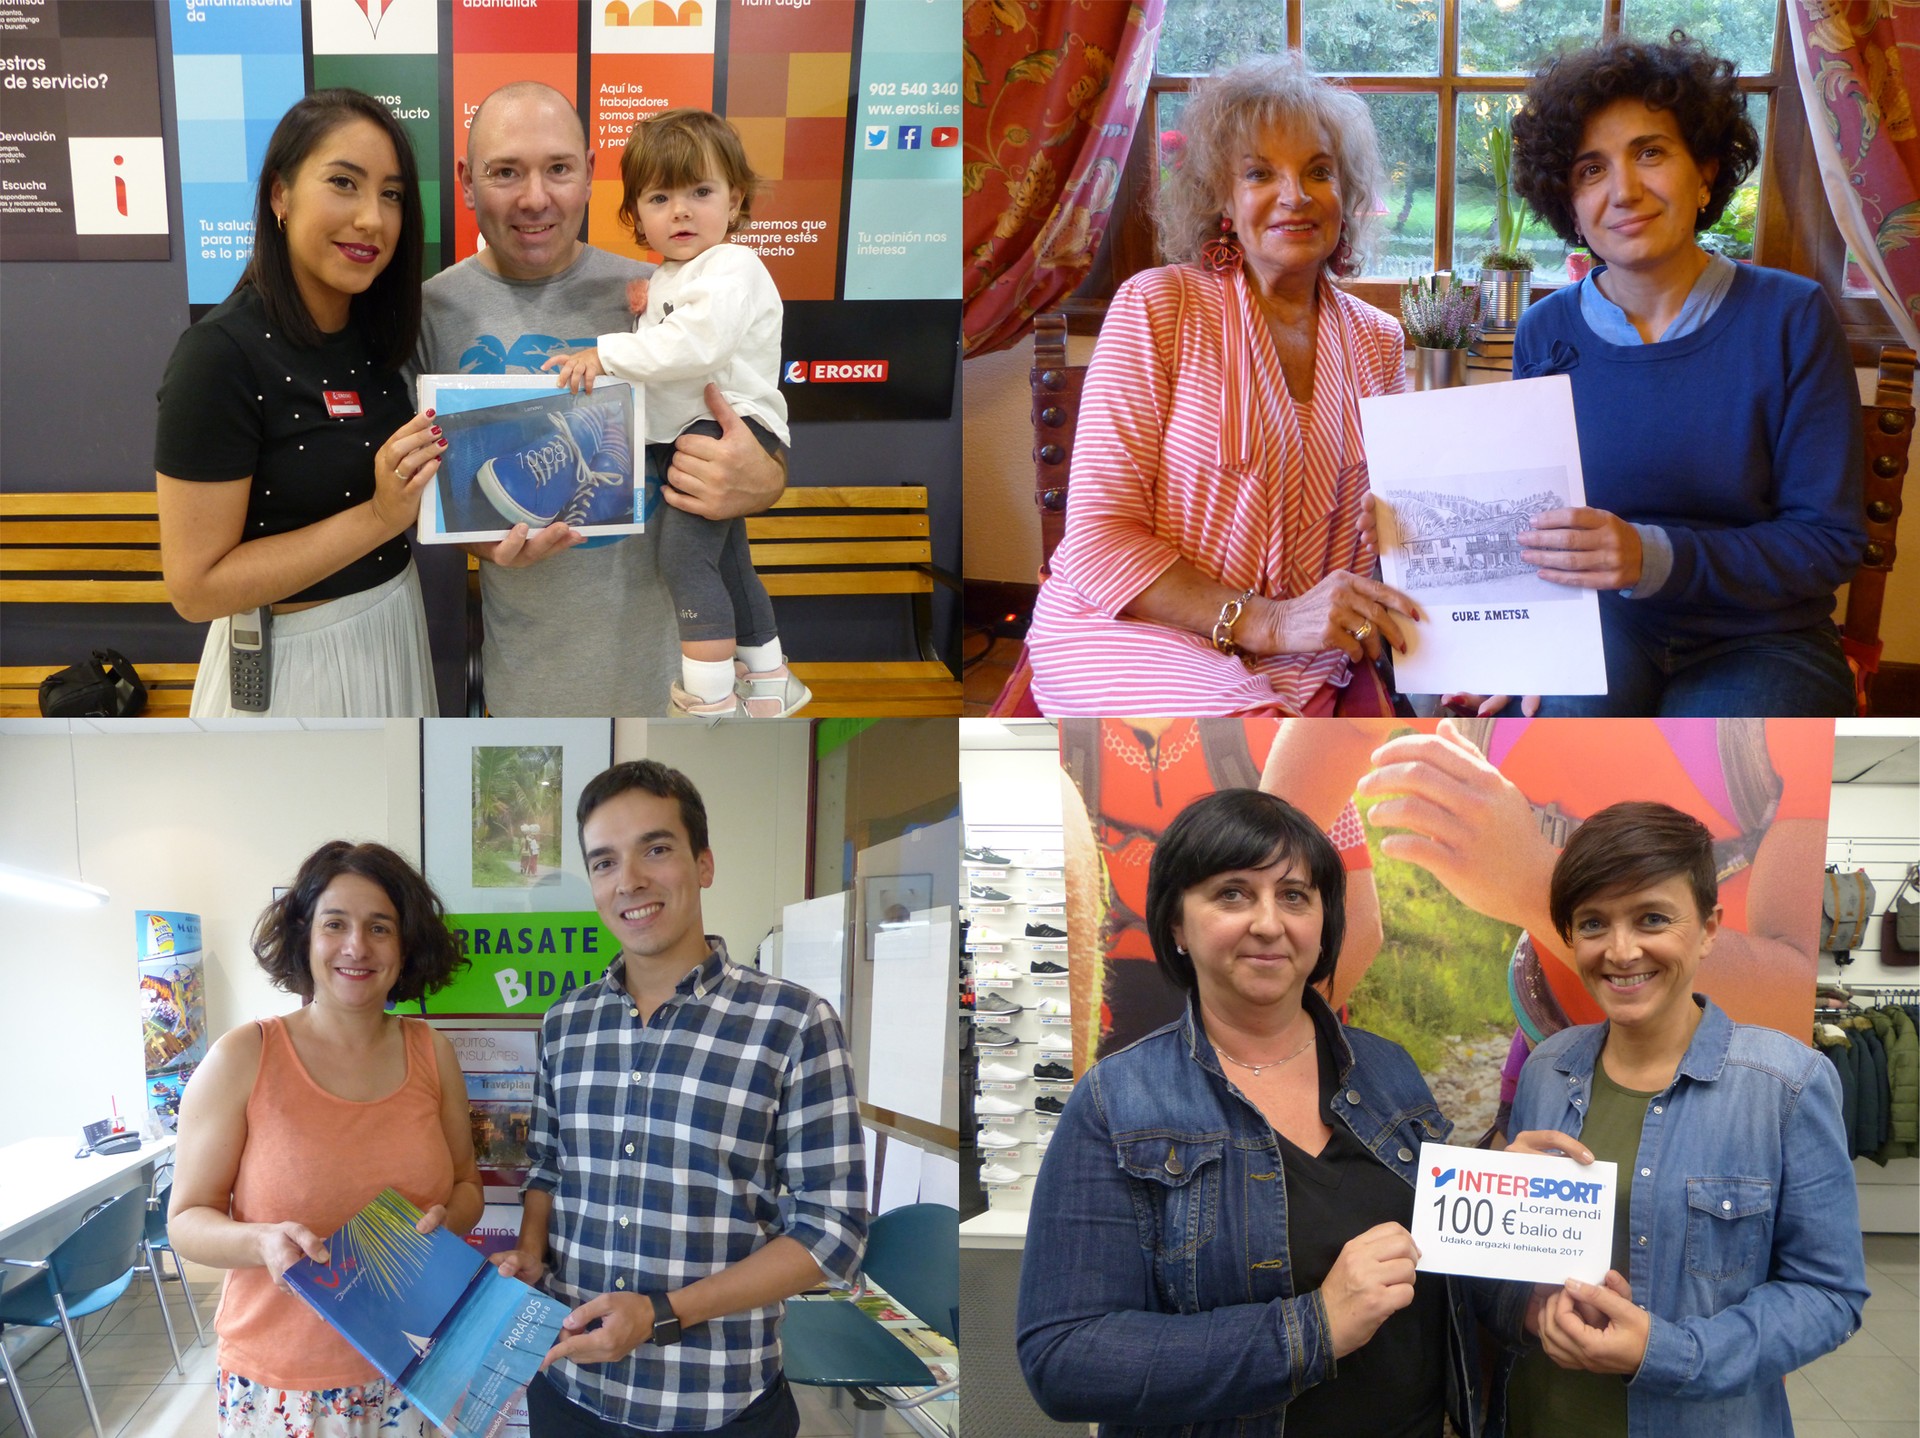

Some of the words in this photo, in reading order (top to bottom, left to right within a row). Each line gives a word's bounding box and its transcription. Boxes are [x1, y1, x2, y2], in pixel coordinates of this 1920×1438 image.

[187, 9, 206, 22] da
[4, 73, 28, 90] de
[32, 72, 109, 90] servicio?
[600, 82, 626, 95] Aquí
[628, 83, 643, 94] los
[868, 83, 896, 96] 902
[900, 83, 928, 96] 540
[931, 83, 959, 96] 340
[463, 102, 479, 115] La
[600, 96, 669, 109] trabajadores
[599, 111, 634, 121] somos
[599, 125, 606, 136] y
[608, 123, 624, 134] los
[599, 138, 606, 149] y
[2, 180, 47, 191] Escucha
[199, 219, 214, 232] Tu
[749, 220, 798, 230] eremos
[801, 220, 827, 234] que
[200, 235, 232, 248] para
[730, 232, 782, 245] siempre
[785, 230, 818, 243] estés
[857, 231, 872, 243] Tu
[874, 230, 921, 245] opinión
[925, 232, 948, 243] nos
[201, 249, 217, 259] es
[219, 247, 232, 259] lo
[857, 244, 907, 256] interesa
[814, 364, 884, 379] EROSKI
[515, 444, 565, 469] 10:08
[635, 490, 644, 522] Lenovo
[1451, 610, 1481, 622] GURE
[1484, 608, 1530, 621] AMETSA
[1458, 1169, 1603, 1205] INTERSPORT
[1433, 1194, 1494, 1237] 100
[1501, 1209, 1517, 1236] €
[1519, 1221, 1558, 1239] balio
[1562, 1226, 1582, 1241] du
[1519, 1201, 1602, 1221] Loramendi
[1440, 1235, 1473, 1246] Udako
[1474, 1240, 1511, 1249] argazki
[1513, 1243, 1558, 1255] lehiaketa
[1560, 1247, 1584, 1257] 2017
[503, 1298, 542, 1351] PARAÍSOS
[524, 1305, 551, 1344] 2017-2018
